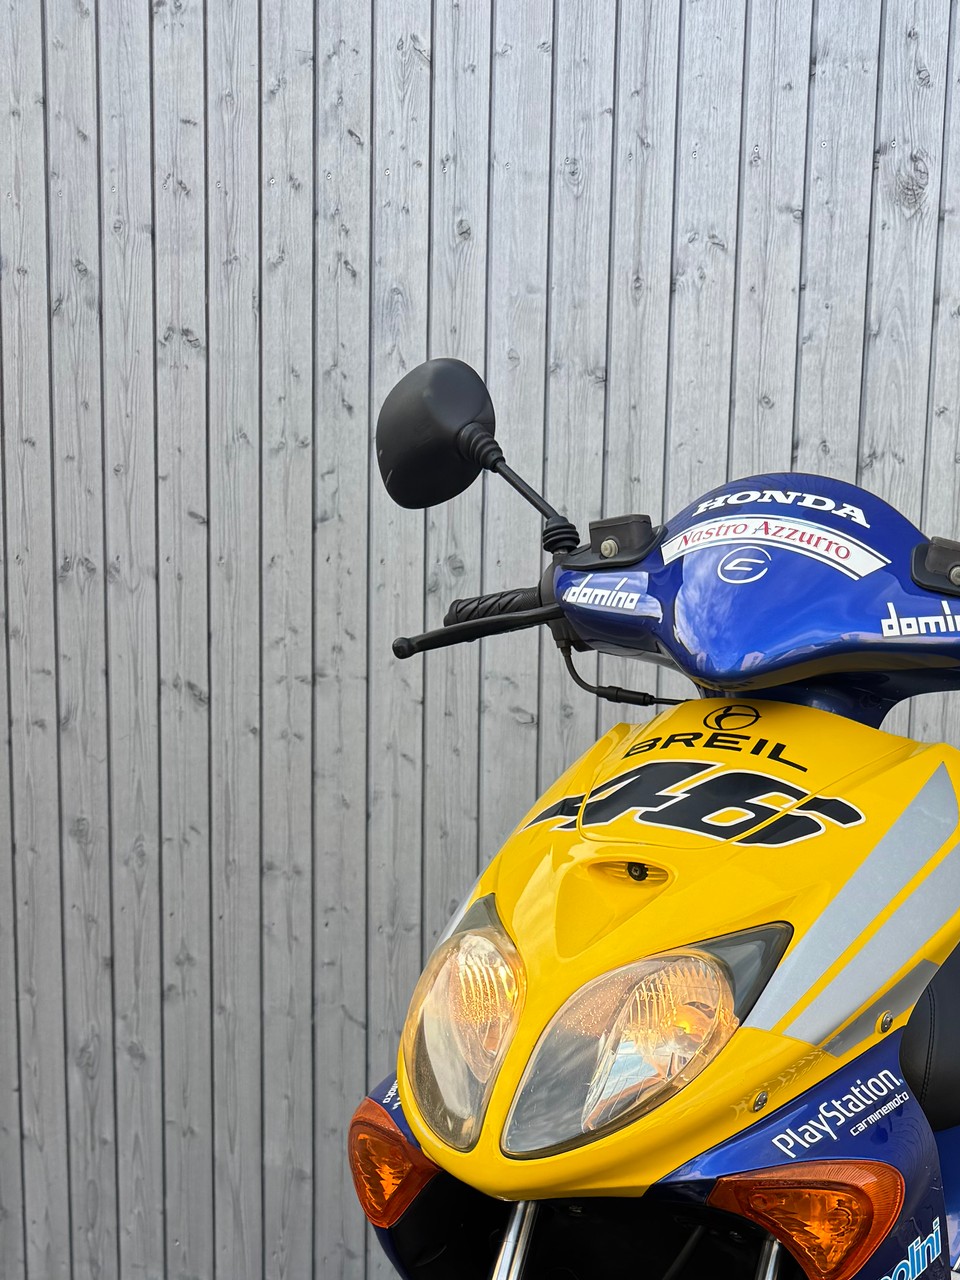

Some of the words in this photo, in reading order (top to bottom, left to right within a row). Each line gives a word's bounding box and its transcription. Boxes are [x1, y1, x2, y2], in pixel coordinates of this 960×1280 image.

[692, 490, 871, 529] HONDA
[677, 522, 748, 550] Nastro
[752, 520, 851, 560] Azzurro
[566, 574, 640, 610] domino
[621, 732, 808, 773] BREIL
[519, 760, 866, 848] 46
[771, 1069, 901, 1158] PlayStation
[849, 1091, 909, 1137] carminemoto
